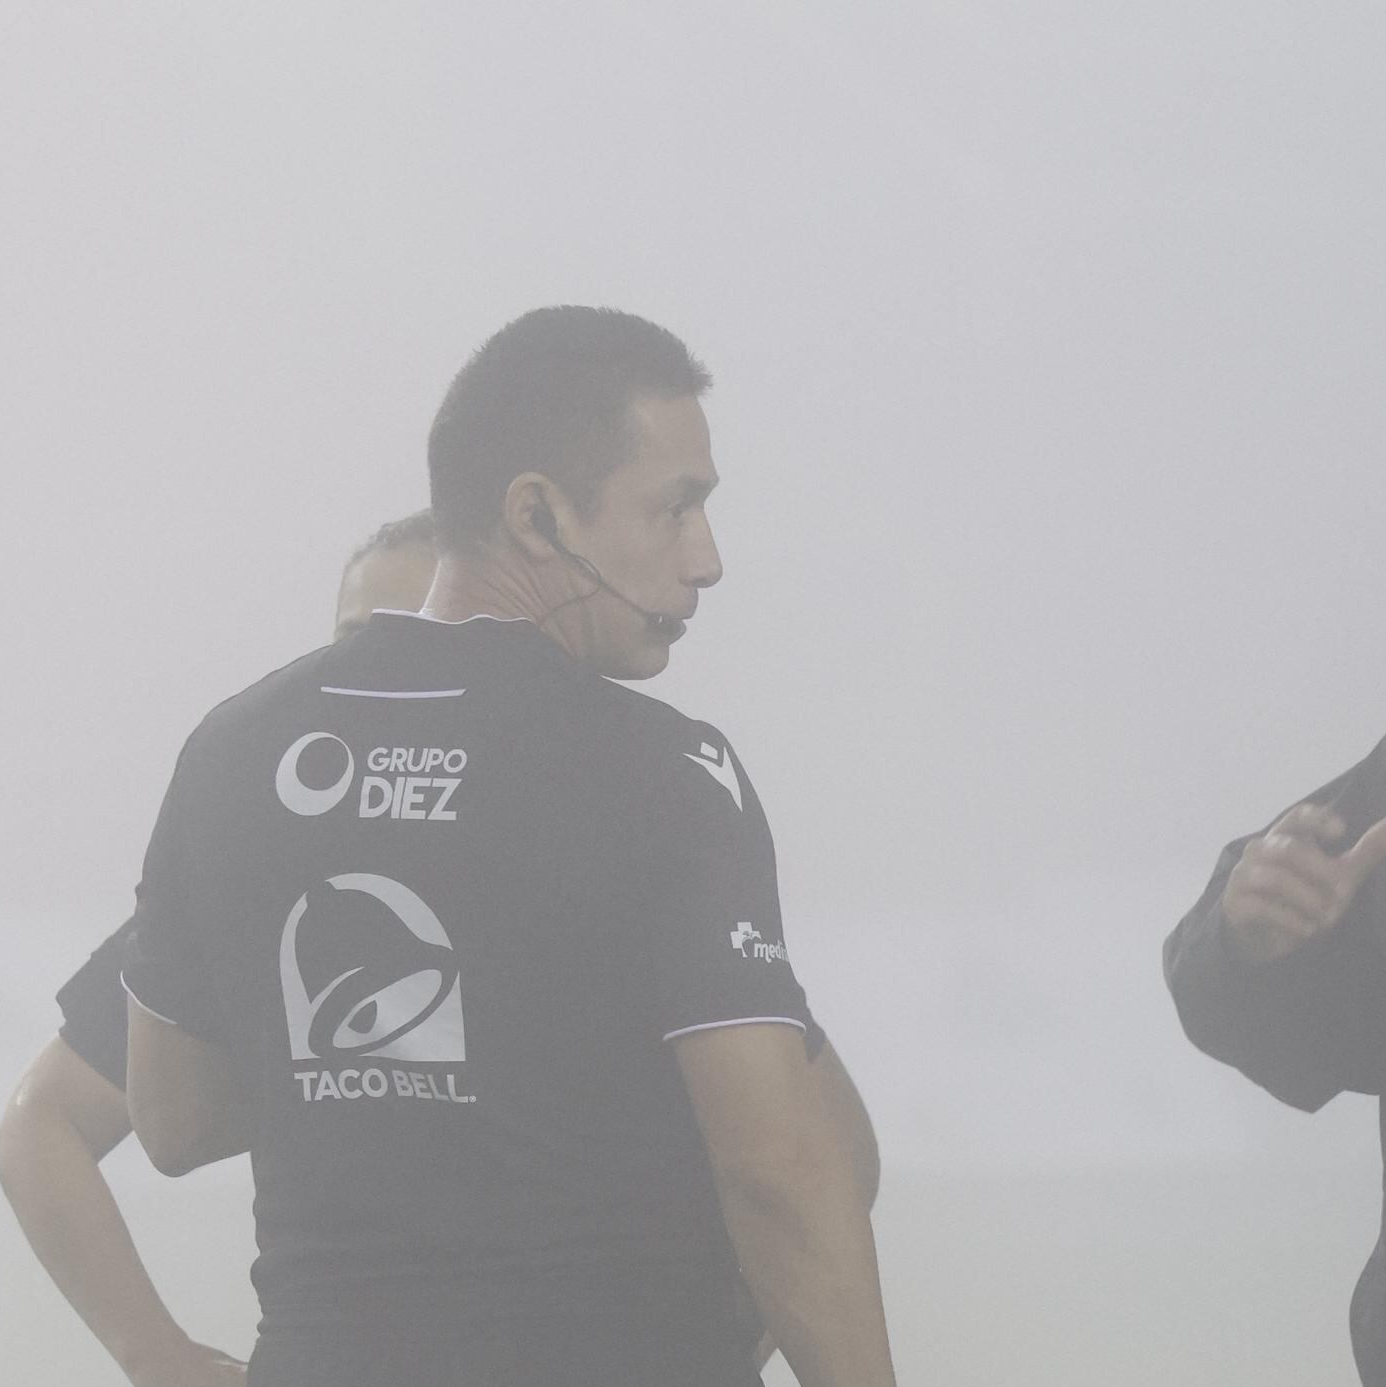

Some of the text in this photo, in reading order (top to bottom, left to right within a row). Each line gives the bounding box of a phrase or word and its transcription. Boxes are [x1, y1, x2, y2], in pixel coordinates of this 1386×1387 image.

[367, 747, 468, 774] GRUPO
[359, 776, 462, 821] DIEZ
[294, 1068, 388, 1102] TACO
